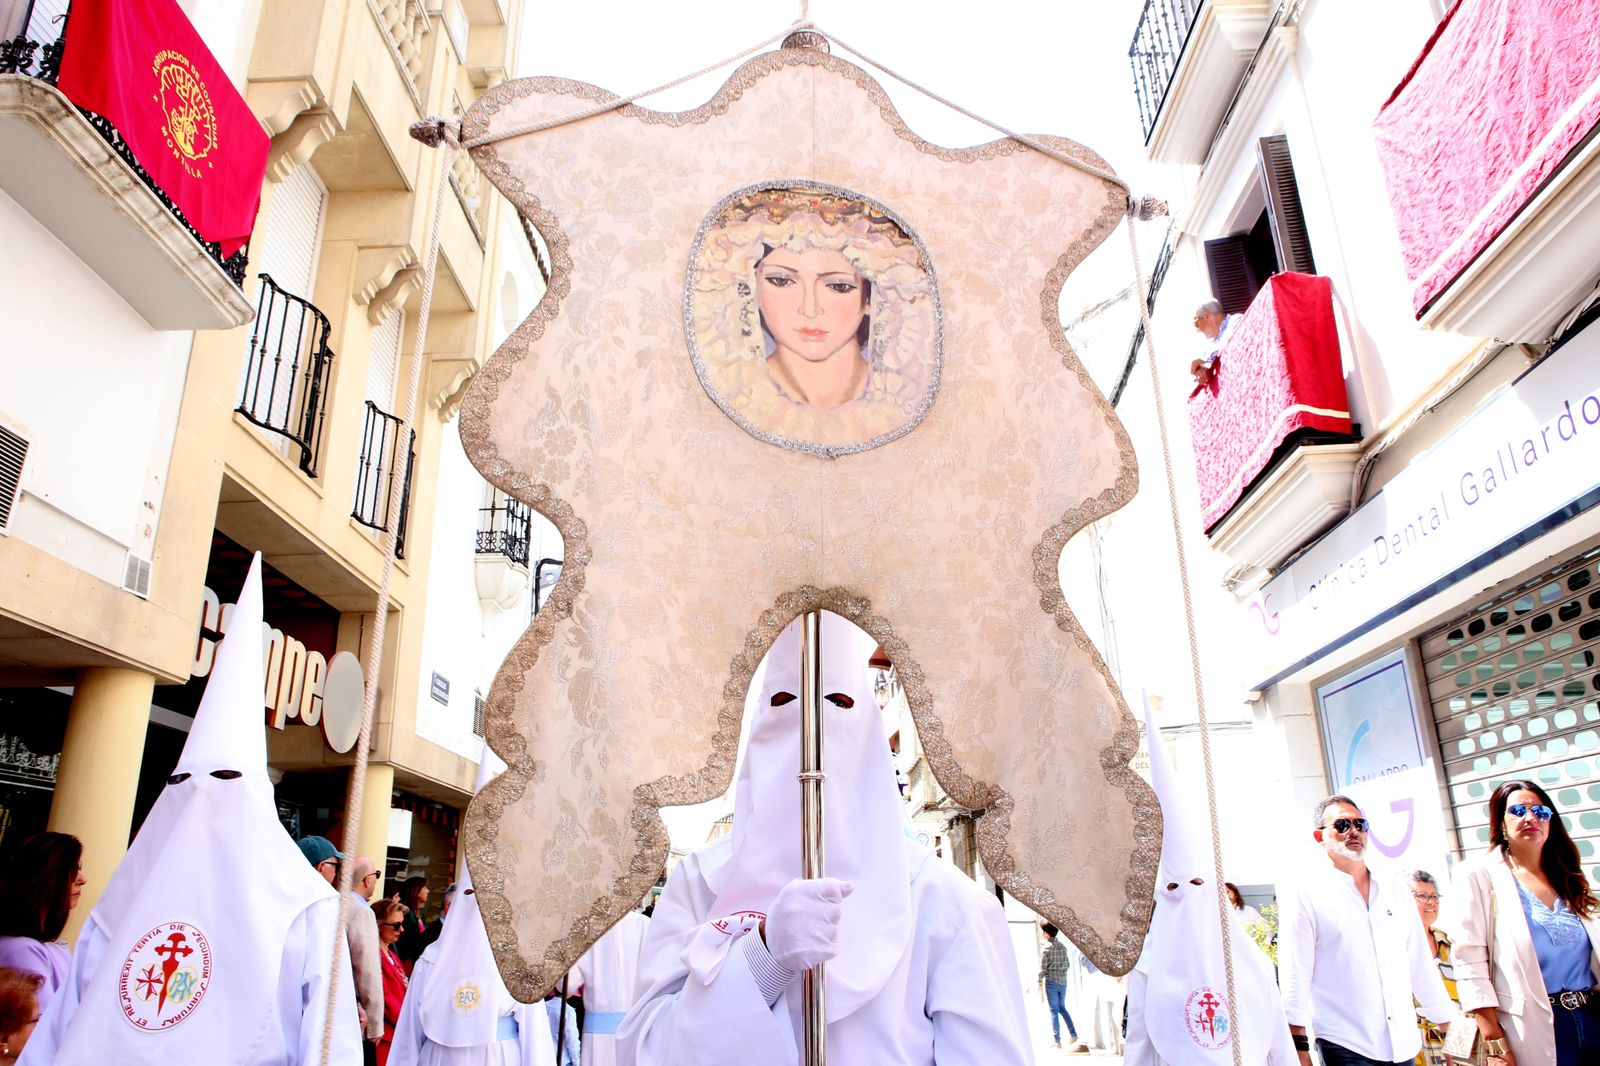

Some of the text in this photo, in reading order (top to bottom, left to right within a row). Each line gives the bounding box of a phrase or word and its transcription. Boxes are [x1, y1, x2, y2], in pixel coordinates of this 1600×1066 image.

[190, 64, 201, 81] DE
[199, 81, 219, 150] COFRADIAS
[161, 126, 202, 178] MONTILLA
[1374, 491, 1451, 566] Dental
[1460, 395, 1600, 506] Gallardo
[133, 928, 162, 954] TERTIA
[192, 931, 210, 979] SECUNDUM
[136, 1018, 147, 1026] ET
